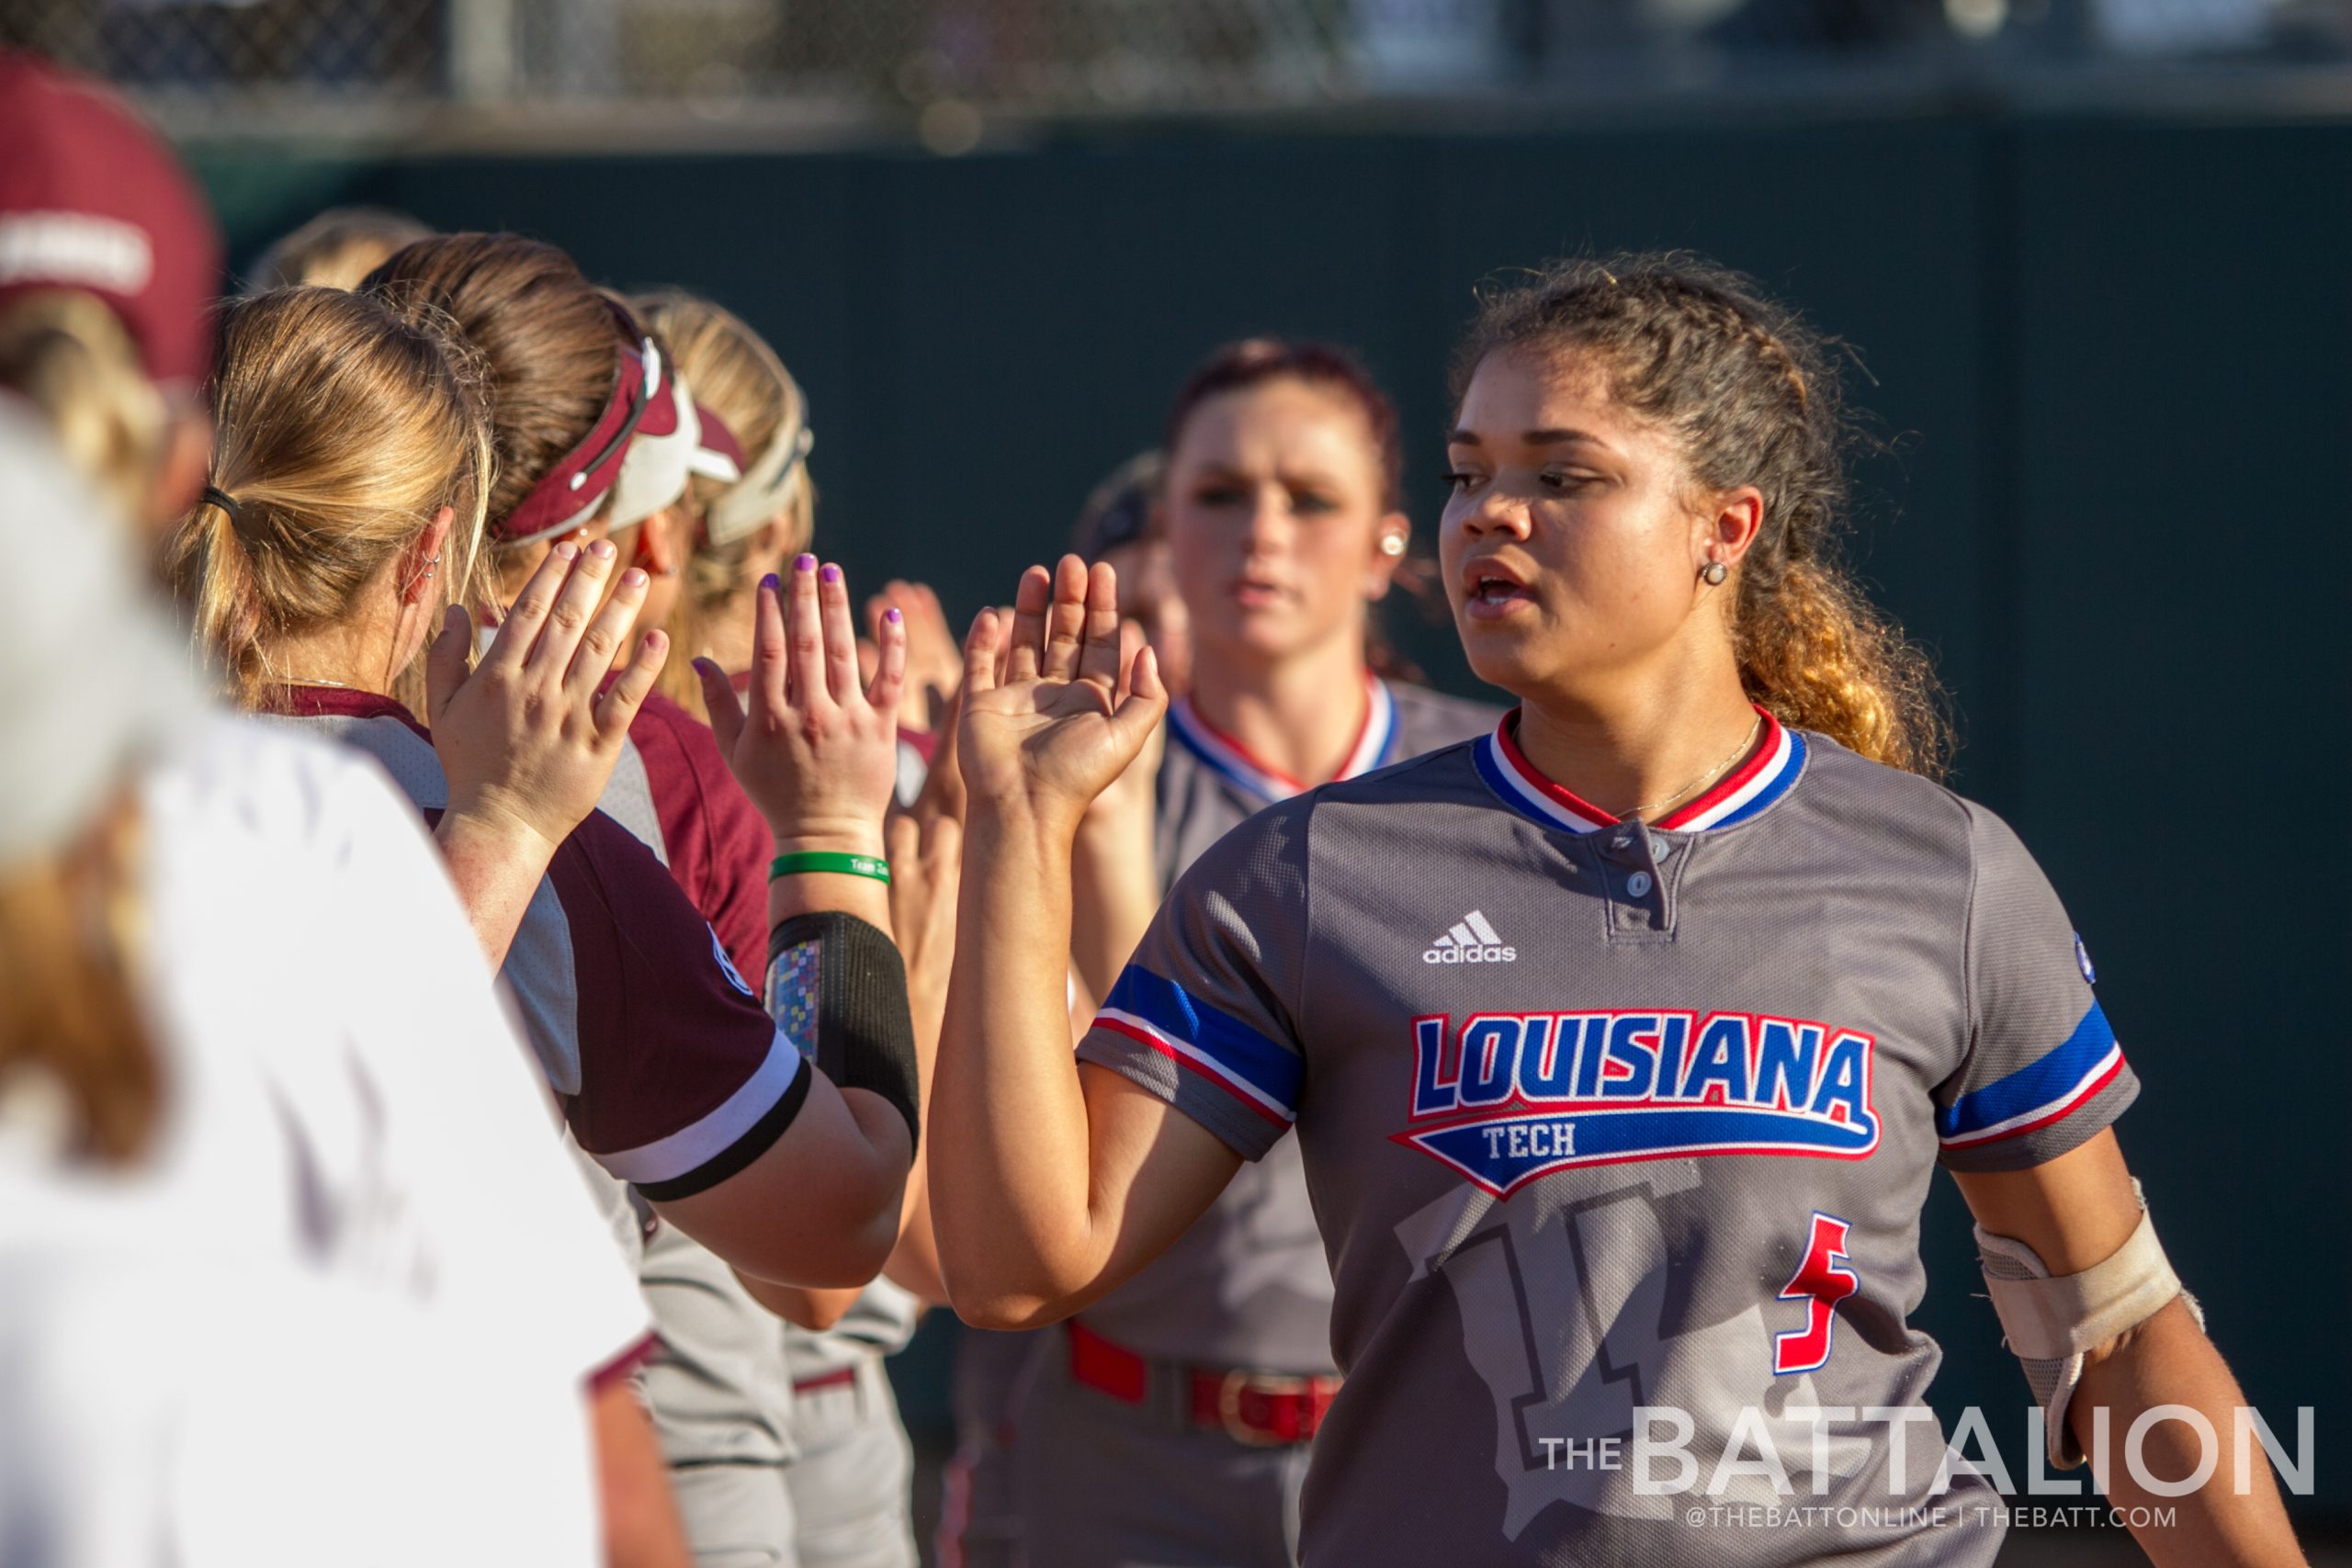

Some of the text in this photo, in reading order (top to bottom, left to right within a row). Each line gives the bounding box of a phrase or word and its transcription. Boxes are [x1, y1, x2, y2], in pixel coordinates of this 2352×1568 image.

[850, 858, 876, 874] Team
[1422, 946, 1517, 964] adidas
[1408, 1009, 1876, 1126] LOUISIANA
[1482, 1123, 1576, 1158] TECH
